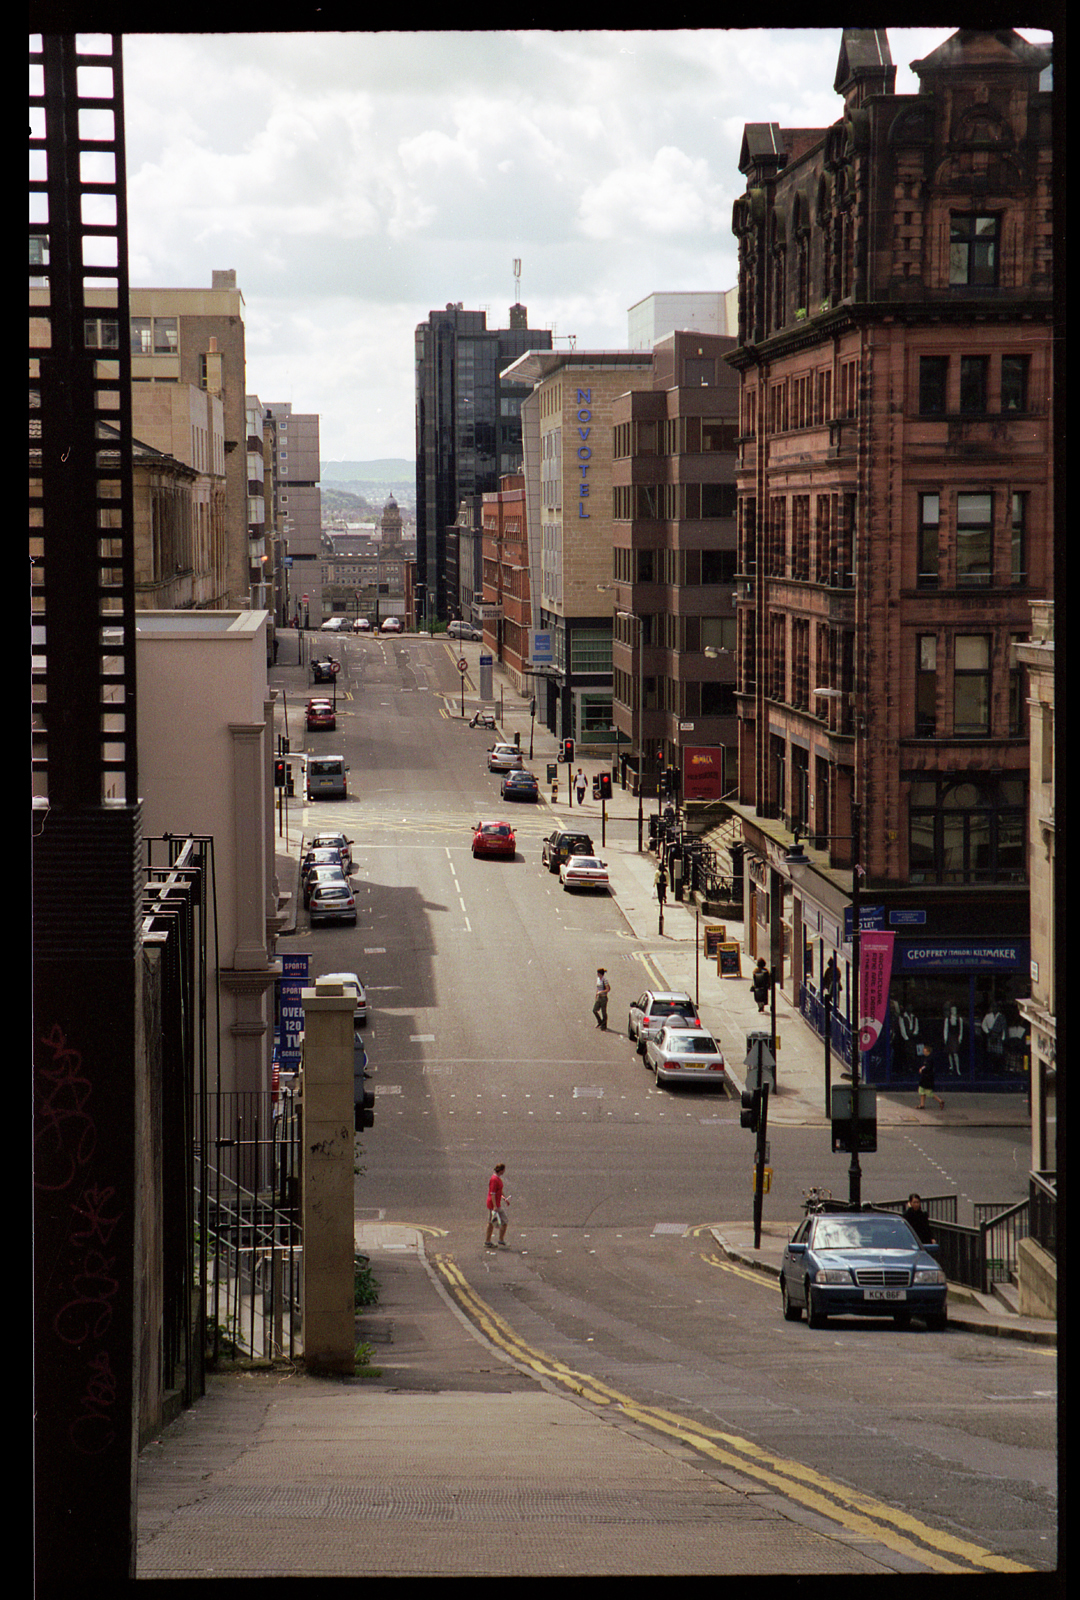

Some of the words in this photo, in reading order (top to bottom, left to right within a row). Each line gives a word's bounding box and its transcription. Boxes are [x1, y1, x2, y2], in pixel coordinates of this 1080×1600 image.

[577, 388, 591, 519] NOVOTEL
[864, 921, 875, 929] LET
[907, 949, 948, 960] GEOFFREY
[973, 948, 1017, 960] KILTMAKER
[284, 962, 307, 970] SPORTS
[282, 987, 302, 995] SPORT
[282, 1007, 305, 1018] OVER
[285, 1020, 302, 1031] 120
[286, 1033, 300, 1048] TV
[869, 1291, 885, 1299] KCK
